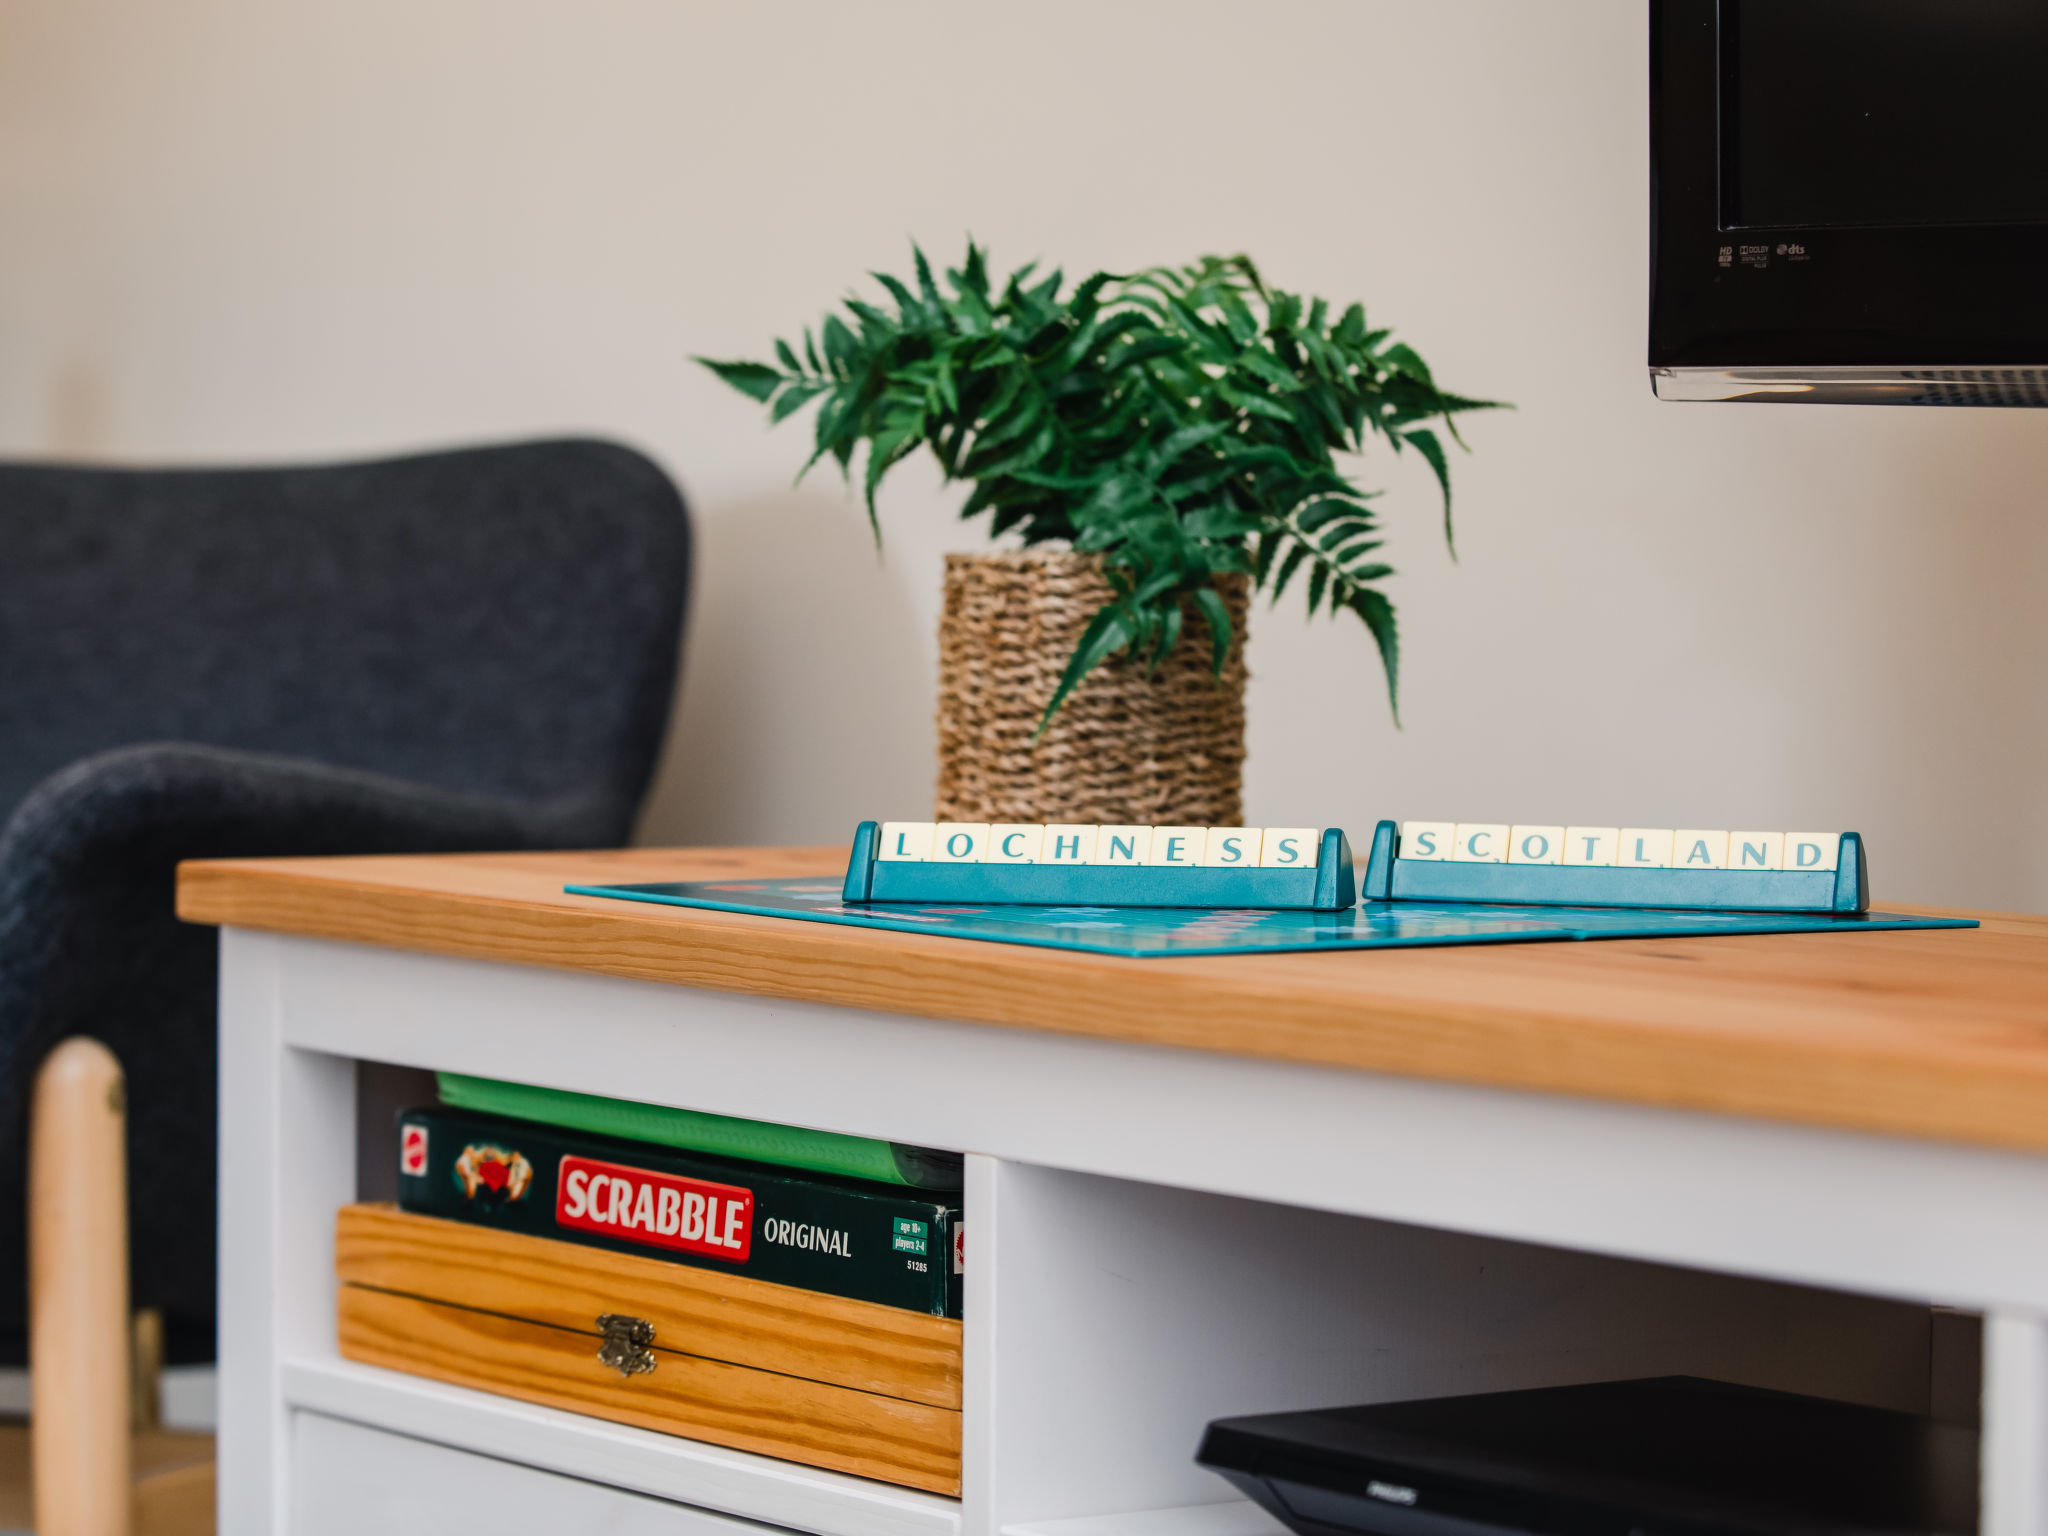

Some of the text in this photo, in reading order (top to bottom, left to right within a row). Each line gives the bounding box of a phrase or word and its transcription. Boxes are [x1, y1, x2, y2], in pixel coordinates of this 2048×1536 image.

[1788, 244, 1805, 254] dts
[896, 832, 1299, 863] LOCHNESS
[1415, 831, 1822, 868] SCOTLAND
[564, 1169, 745, 1250] SCRABBLE
[764, 1217, 852, 1258] ORIGINAL
[900, 1222, 921, 1233] age 10+
[895, 1237, 925, 1252] players 2-4
[907, 1260, 928, 1273] 51285
